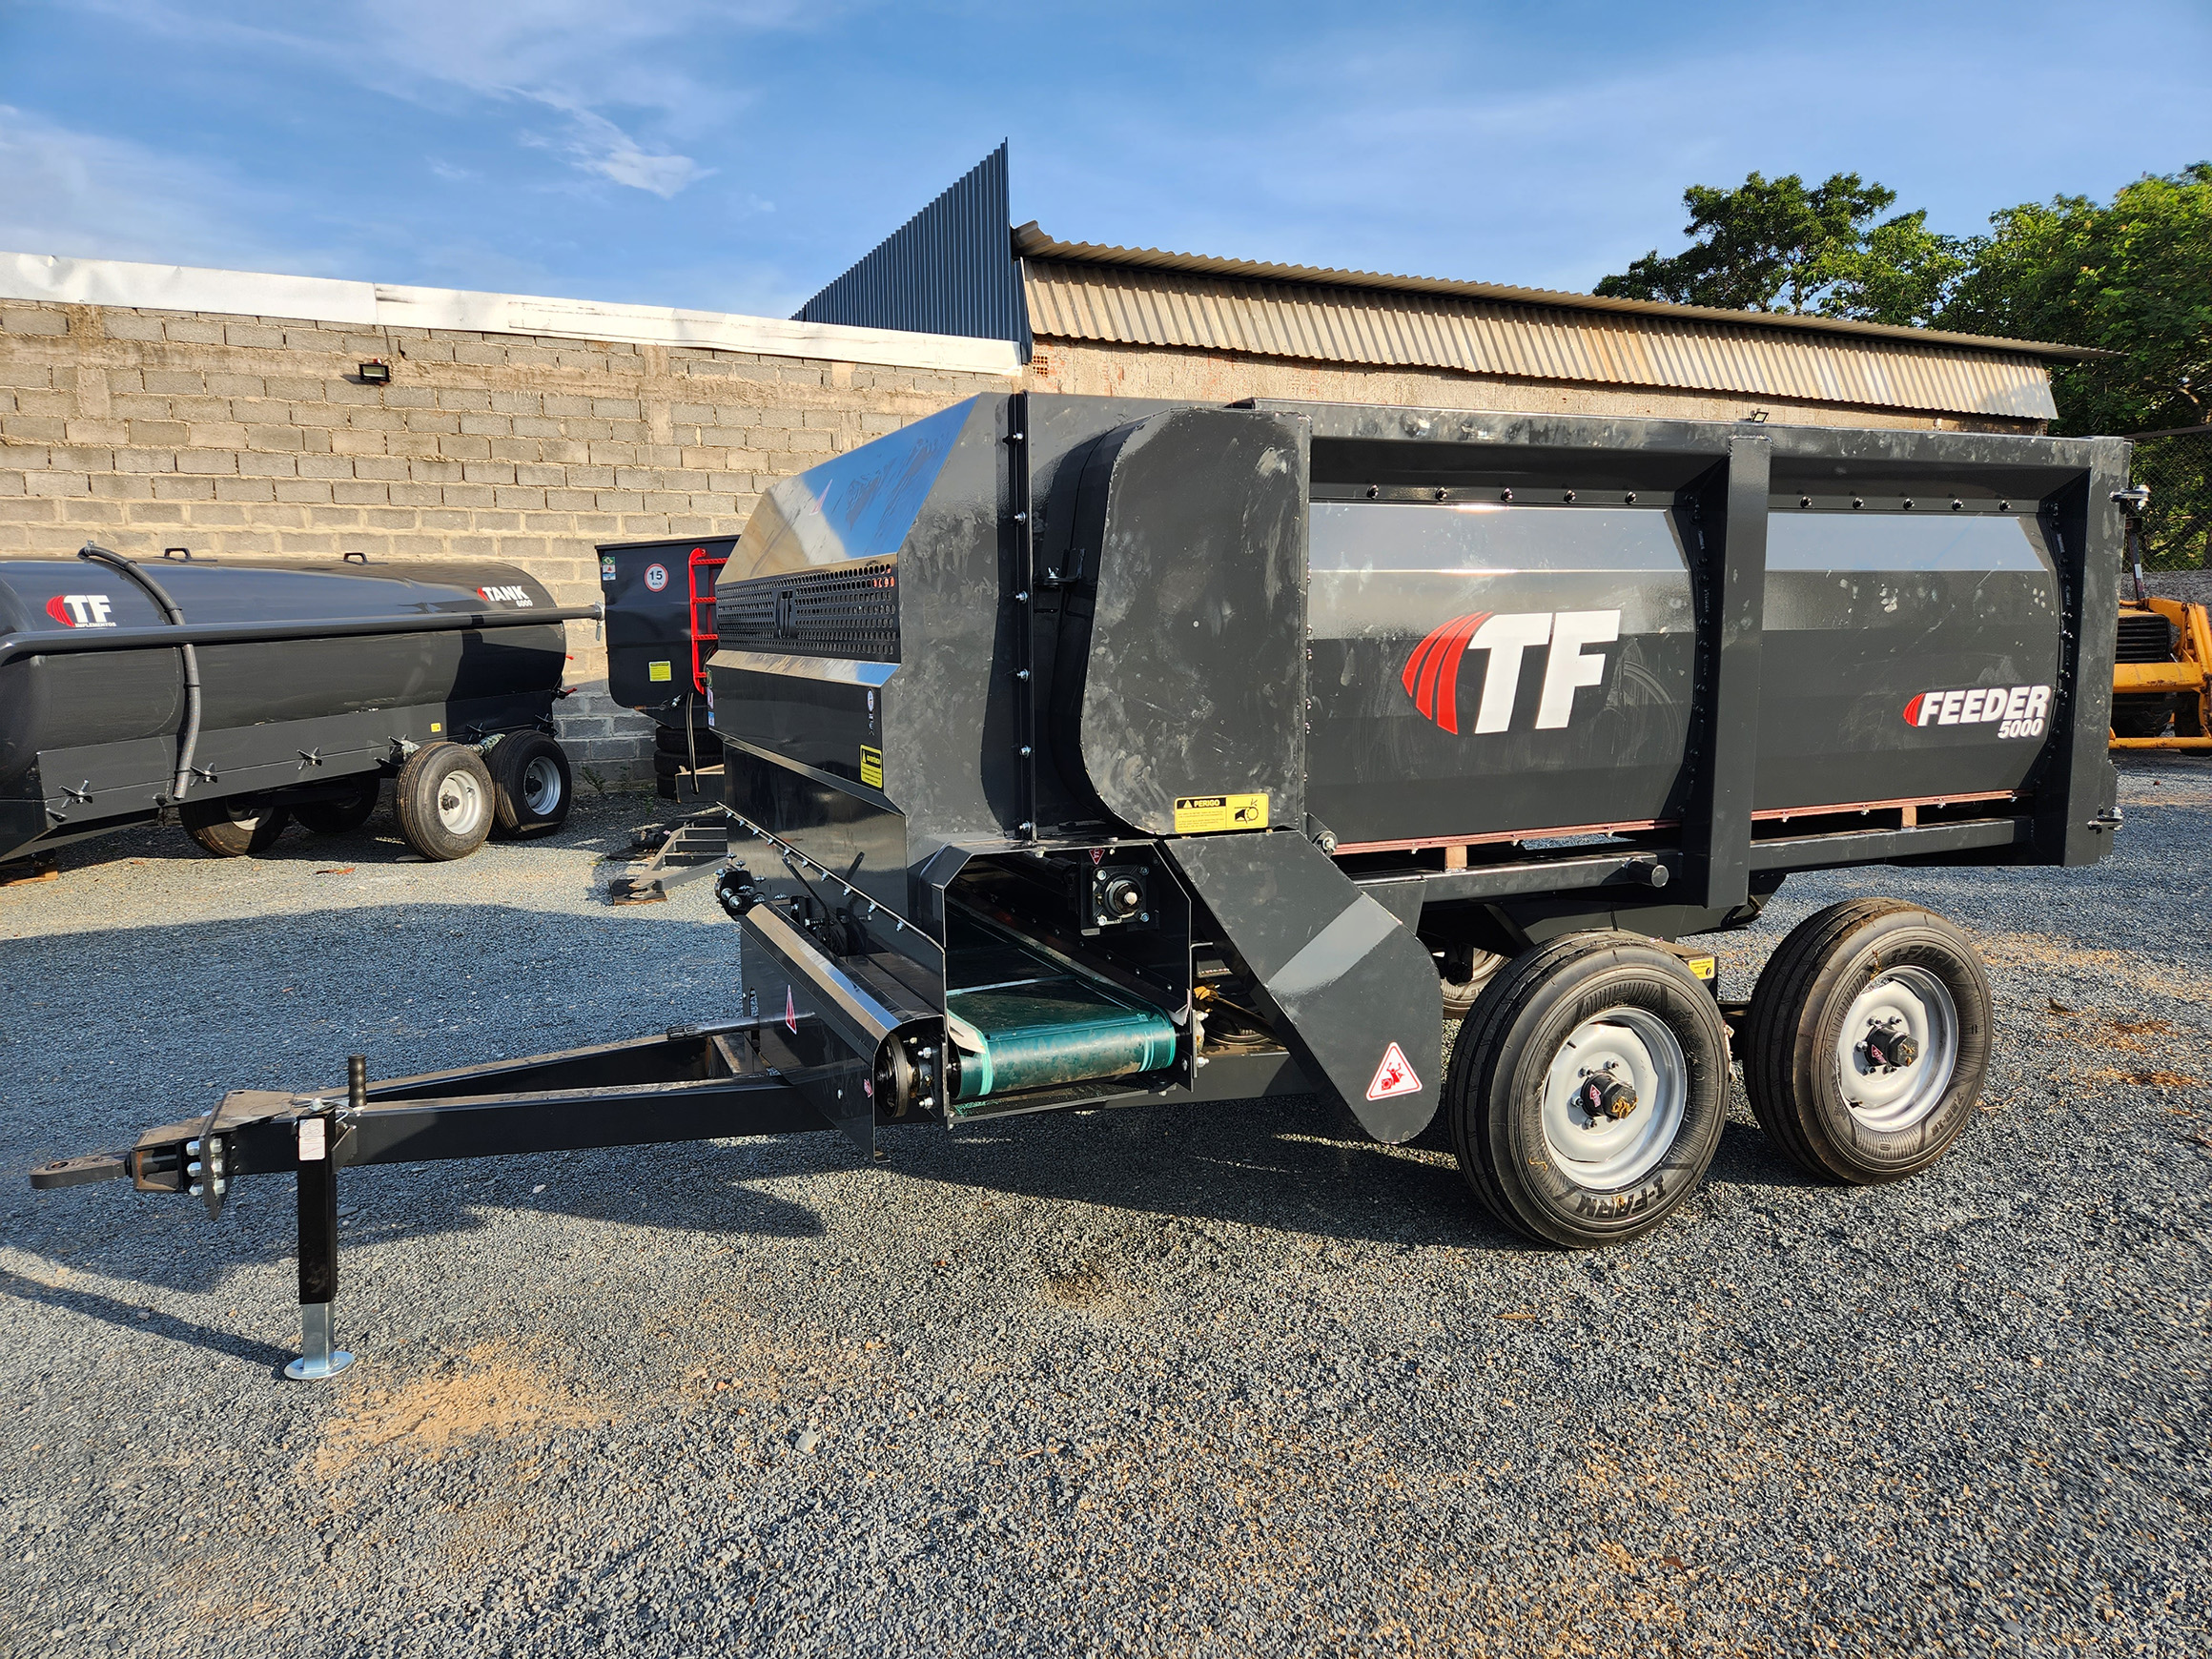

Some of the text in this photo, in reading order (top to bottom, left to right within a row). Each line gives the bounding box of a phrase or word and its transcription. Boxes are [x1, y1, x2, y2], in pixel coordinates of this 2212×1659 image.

[649, 570, 663, 581] 15
[481, 585, 530, 602] TANK
[516, 599, 533, 607] 6000
[63, 594, 112, 624] TF
[1467, 609, 1621, 734] TF
[1917, 686, 2052, 727] FEEDER
[1997, 718, 2045, 739] 5000
[1193, 799, 1220, 808] PERIGO
